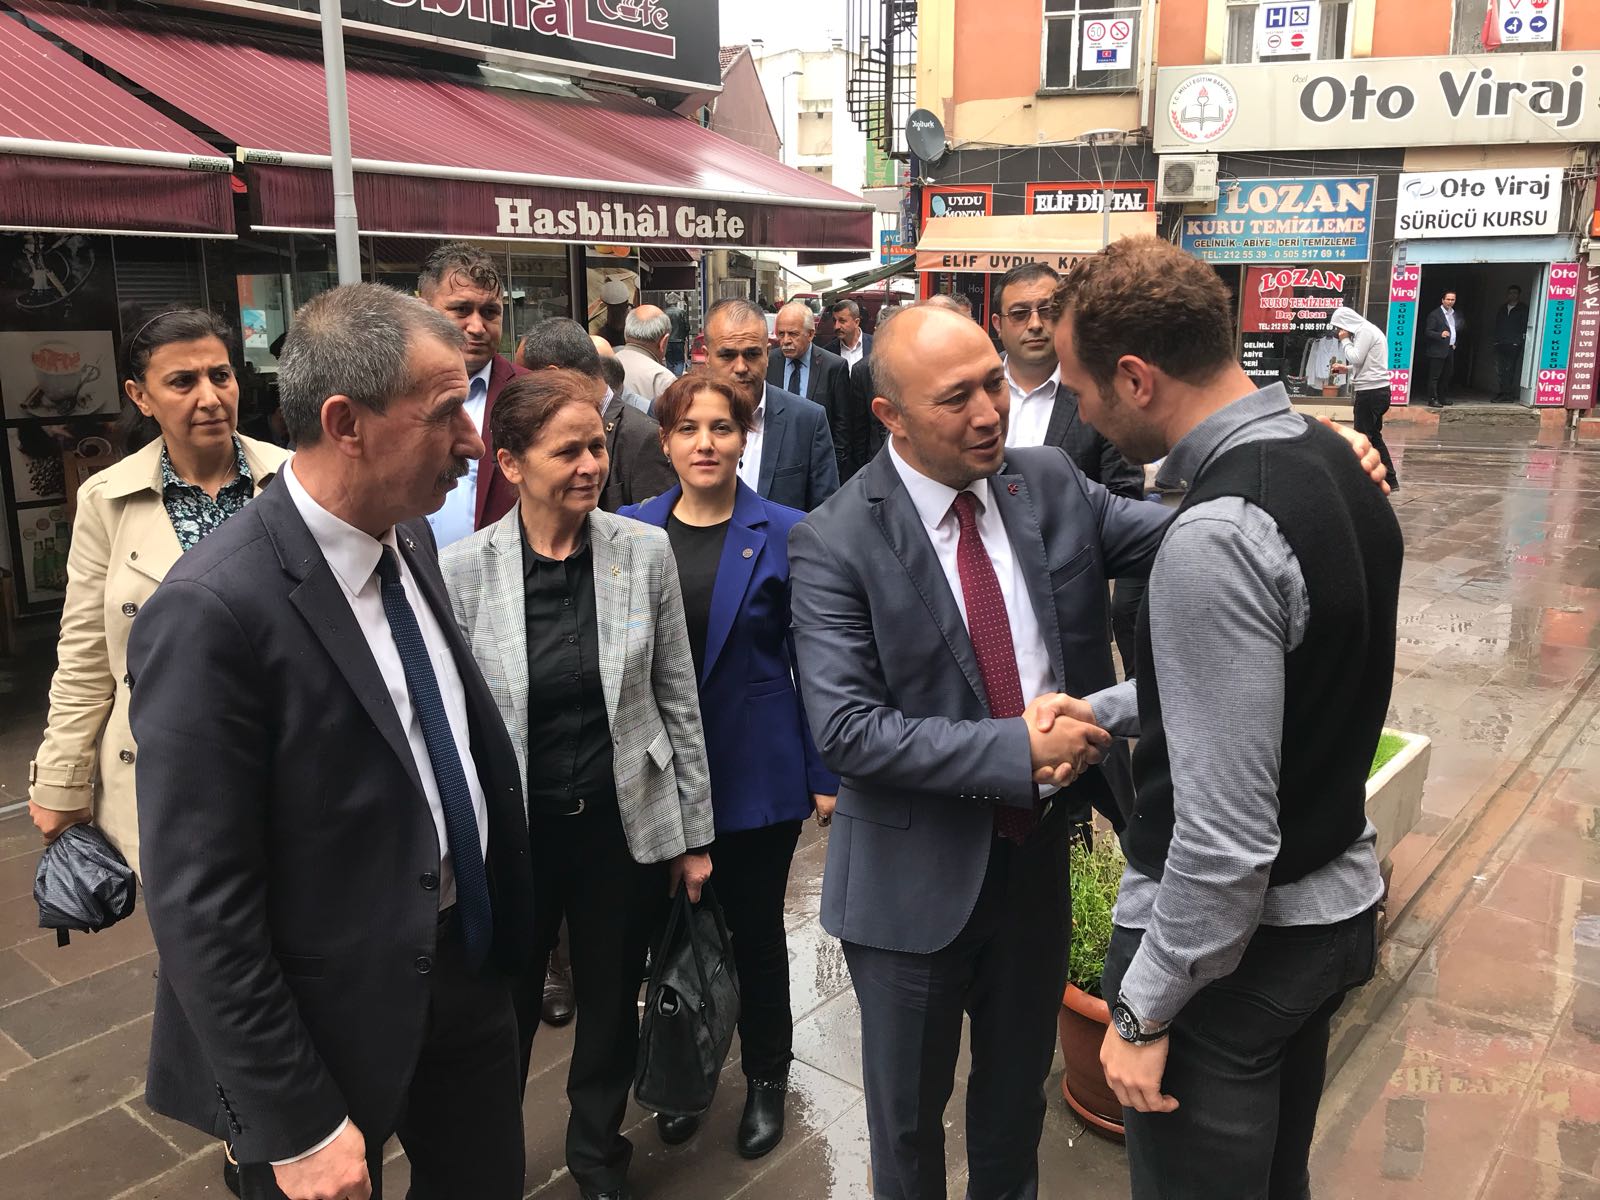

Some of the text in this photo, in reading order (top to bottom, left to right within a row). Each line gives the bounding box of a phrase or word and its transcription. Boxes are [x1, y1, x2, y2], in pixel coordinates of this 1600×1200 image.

[1300, 65, 1584, 127] Oto Viraj
[1440, 174, 1551, 200] Oto Viraj
[948, 196, 983, 206] UYDU
[1035, 189, 1145, 213] ELİF DİJTAL
[1225, 183, 1370, 214] LOZAN
[494, 197, 745, 239] Hasbihâl Cafe
[1400, 209, 1548, 230] SÜRÜCÜ KURSU
[1186, 216, 1366, 236] KURU TEMİZLEME
[1194, 237, 1236, 248] GELİNLİK
[1243, 236, 1271, 247] ABİYE
[1278, 235, 1300, 246] DERİ
[1302, 234, 1356, 246] TEMİZLEME
[942, 253, 978, 268] ELİF
[1202, 251, 1222, 259] TEL:
[1224, 251, 1241, 259] 212
[1242, 251, 1254, 259] 55
[1274, 250, 1280, 258] 0
[1282, 250, 1299, 258] 505
[1302, 250, 1318, 258] 517
[1335, 249, 1345, 257] 14
[1261, 269, 1345, 292] LOZAN
[1551, 268, 1577, 279] Oto
[1392, 287, 1417, 299] Viraj
[1549, 284, 1576, 297] Viraj
[1260, 296, 1344, 308] KURU TEMİZLEME
[1539, 370, 1566, 380] Oto
[1390, 383, 1409, 394] iraj
[1538, 383, 1565, 394] Viraj
